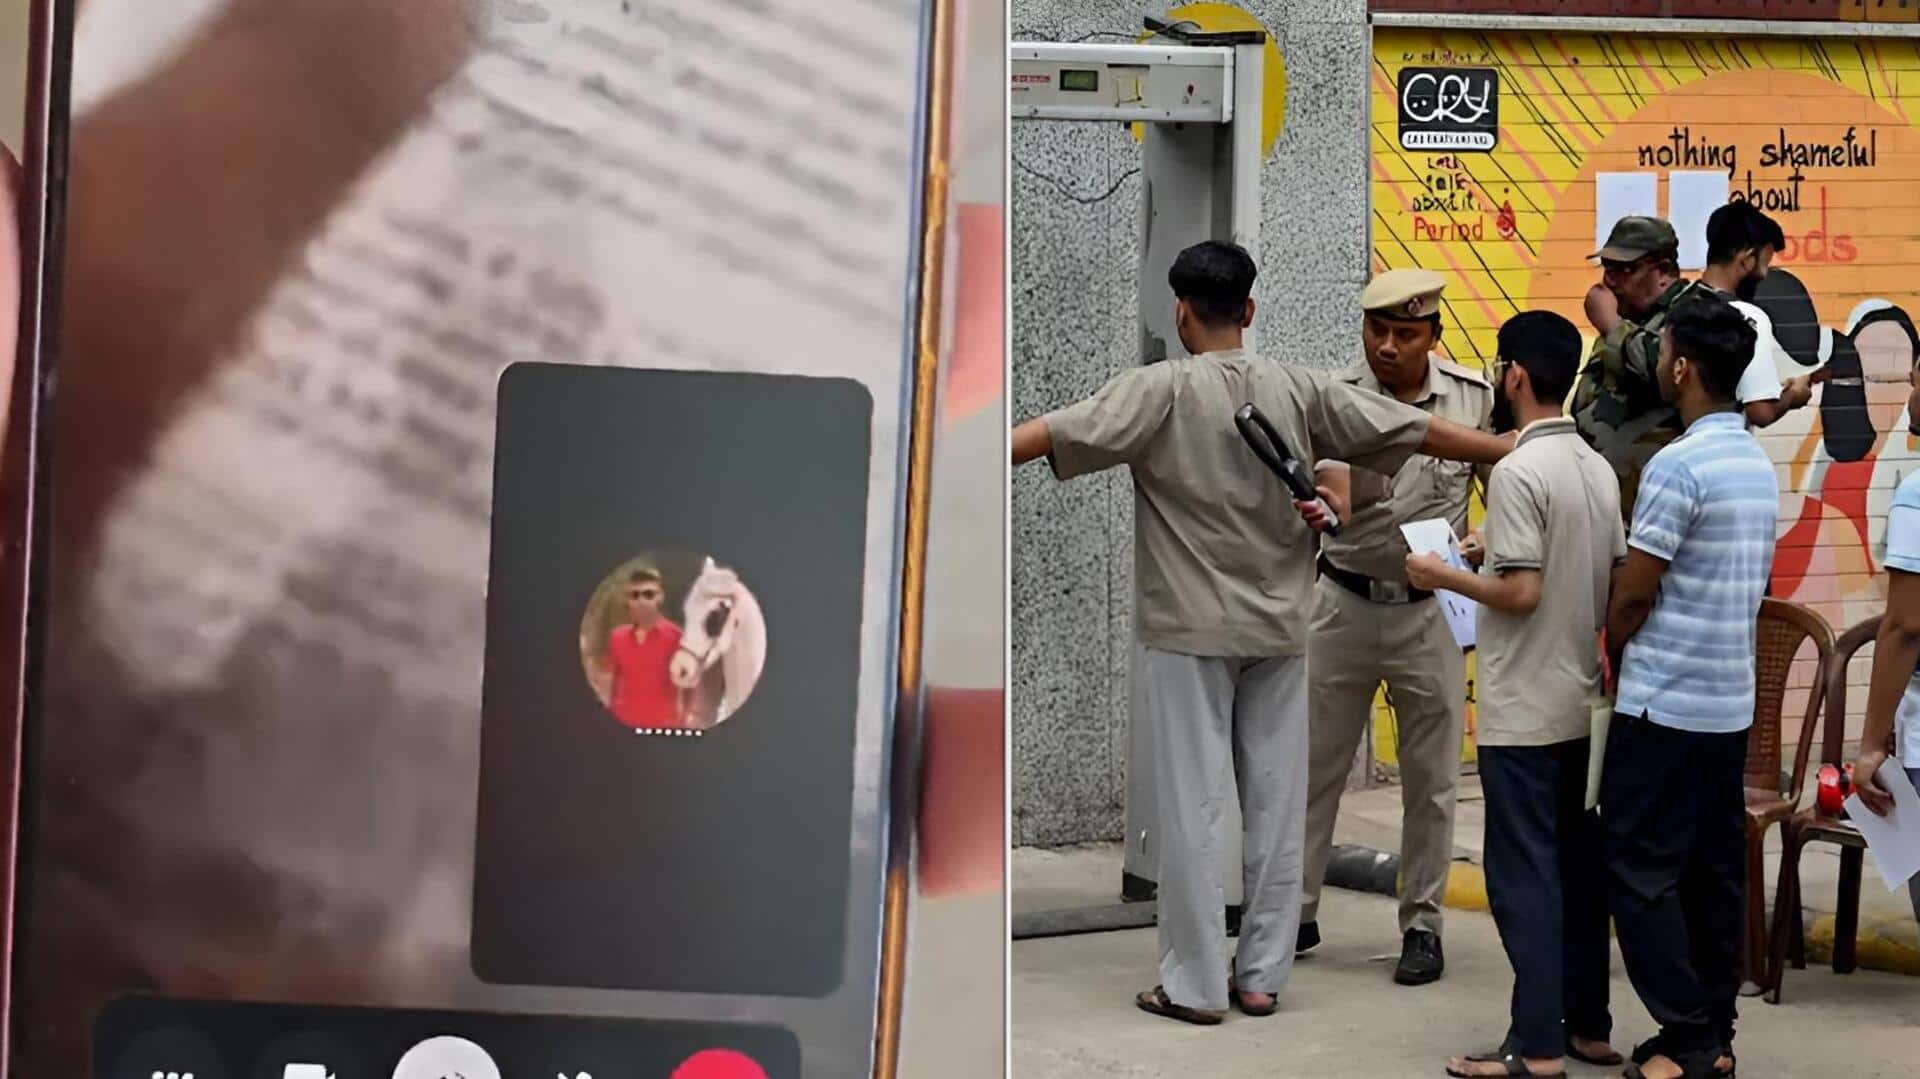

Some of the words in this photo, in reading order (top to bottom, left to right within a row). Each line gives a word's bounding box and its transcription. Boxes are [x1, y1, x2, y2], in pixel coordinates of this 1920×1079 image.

[1403, 73, 1490, 123] CRY
[1638, 126, 1736, 180] nothing
[1759, 127, 1876, 168] shameful
[1728, 168, 1805, 212] about
[1413, 214, 1483, 241] Period
[1775, 186, 1858, 262] ods
